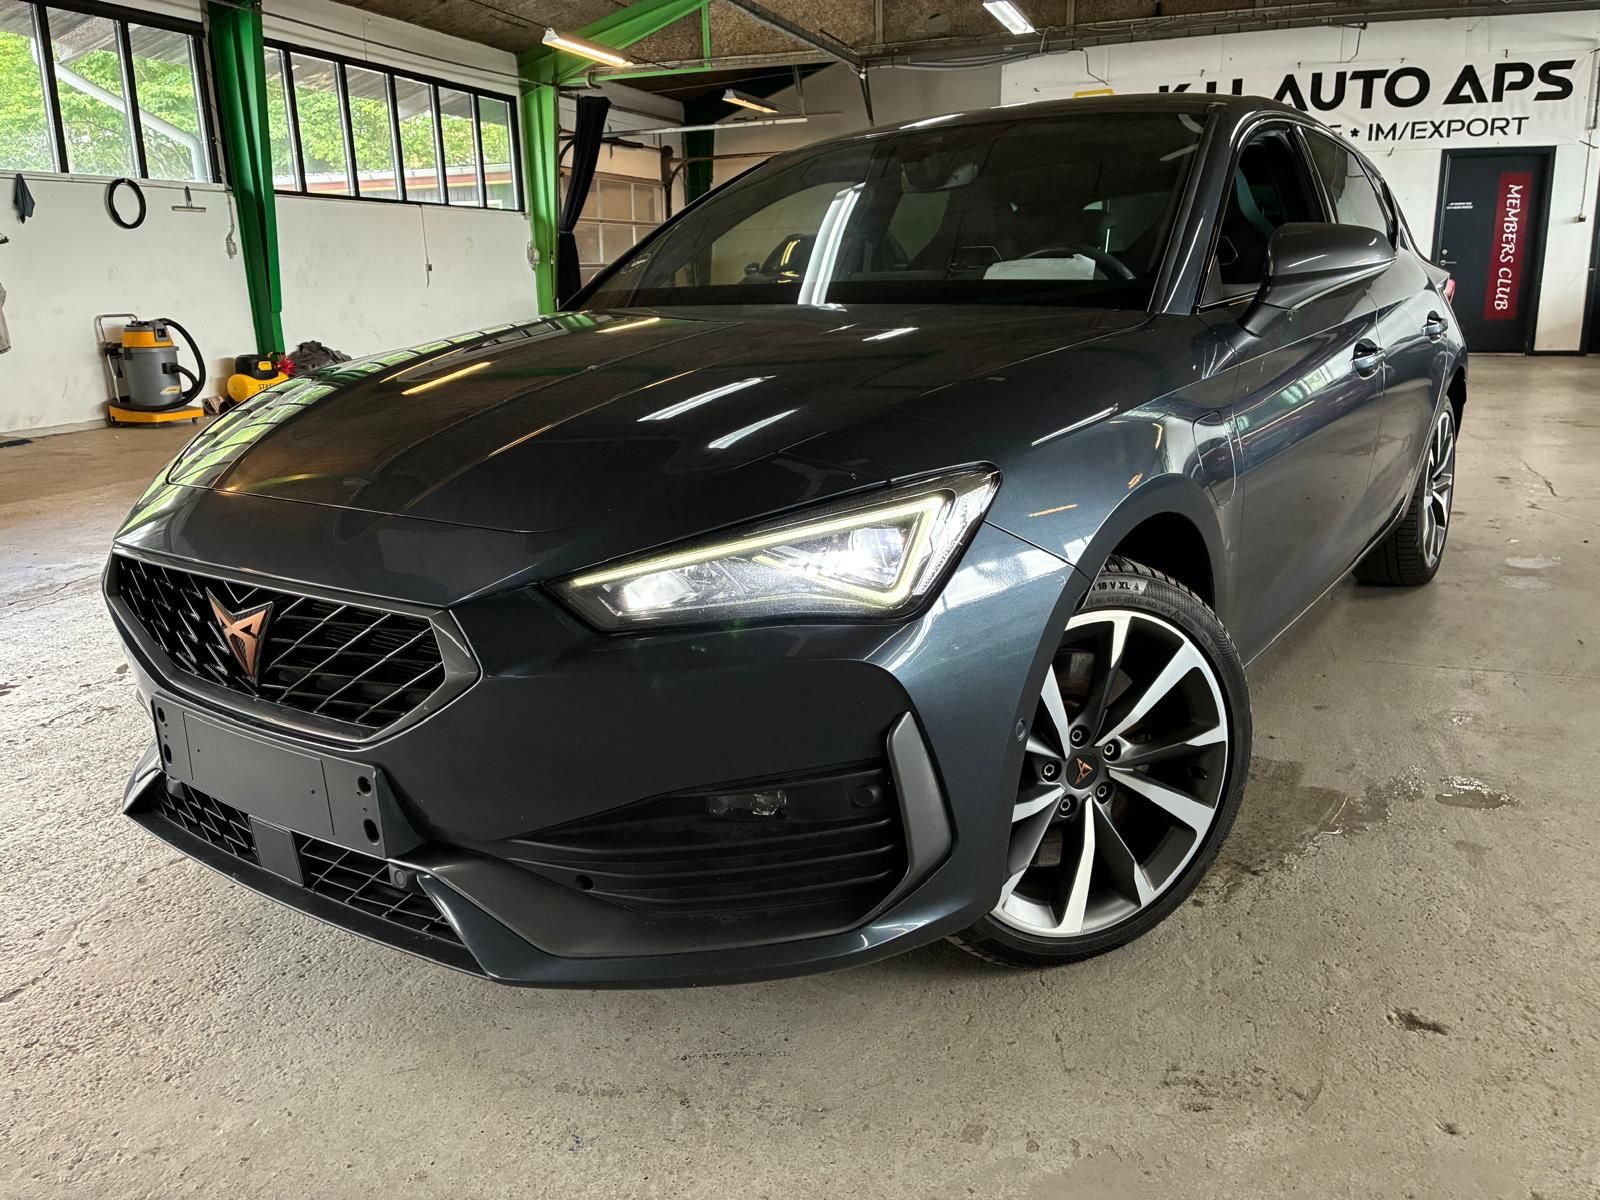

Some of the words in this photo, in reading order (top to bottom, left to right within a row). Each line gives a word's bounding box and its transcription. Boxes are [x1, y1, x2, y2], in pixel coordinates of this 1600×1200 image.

[1273, 66, 1430, 112] AUTO
[1442, 60, 1577, 106] APS
[1367, 116, 1530, 142] IM/EXPORT
[1500, 184, 1524, 263] MEMBERS
[1494, 267, 1512, 311] CLUB
[1119, 581, 1131, 590] XL
